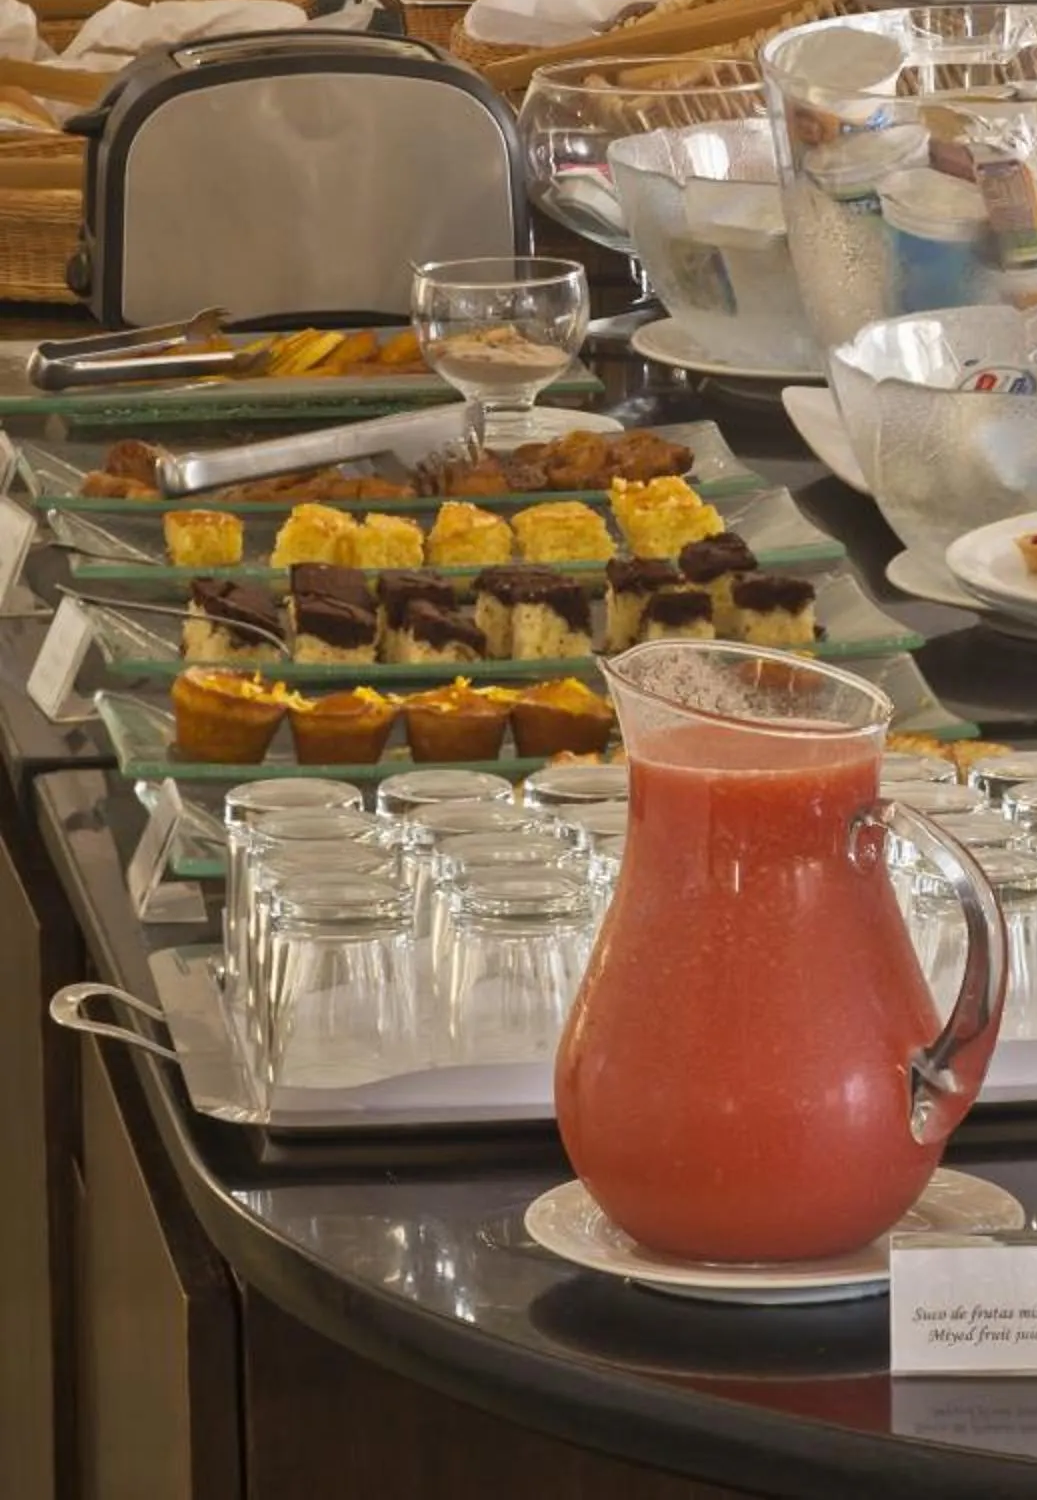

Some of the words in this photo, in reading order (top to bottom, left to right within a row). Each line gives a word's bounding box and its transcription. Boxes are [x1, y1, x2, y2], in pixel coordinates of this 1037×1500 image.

[912, 1306, 947, 1321] Suco
[950, 1305, 967, 1320] de
[968, 1304, 1014, 1325] frutas
[975, 1325, 1011, 1346] fruit
